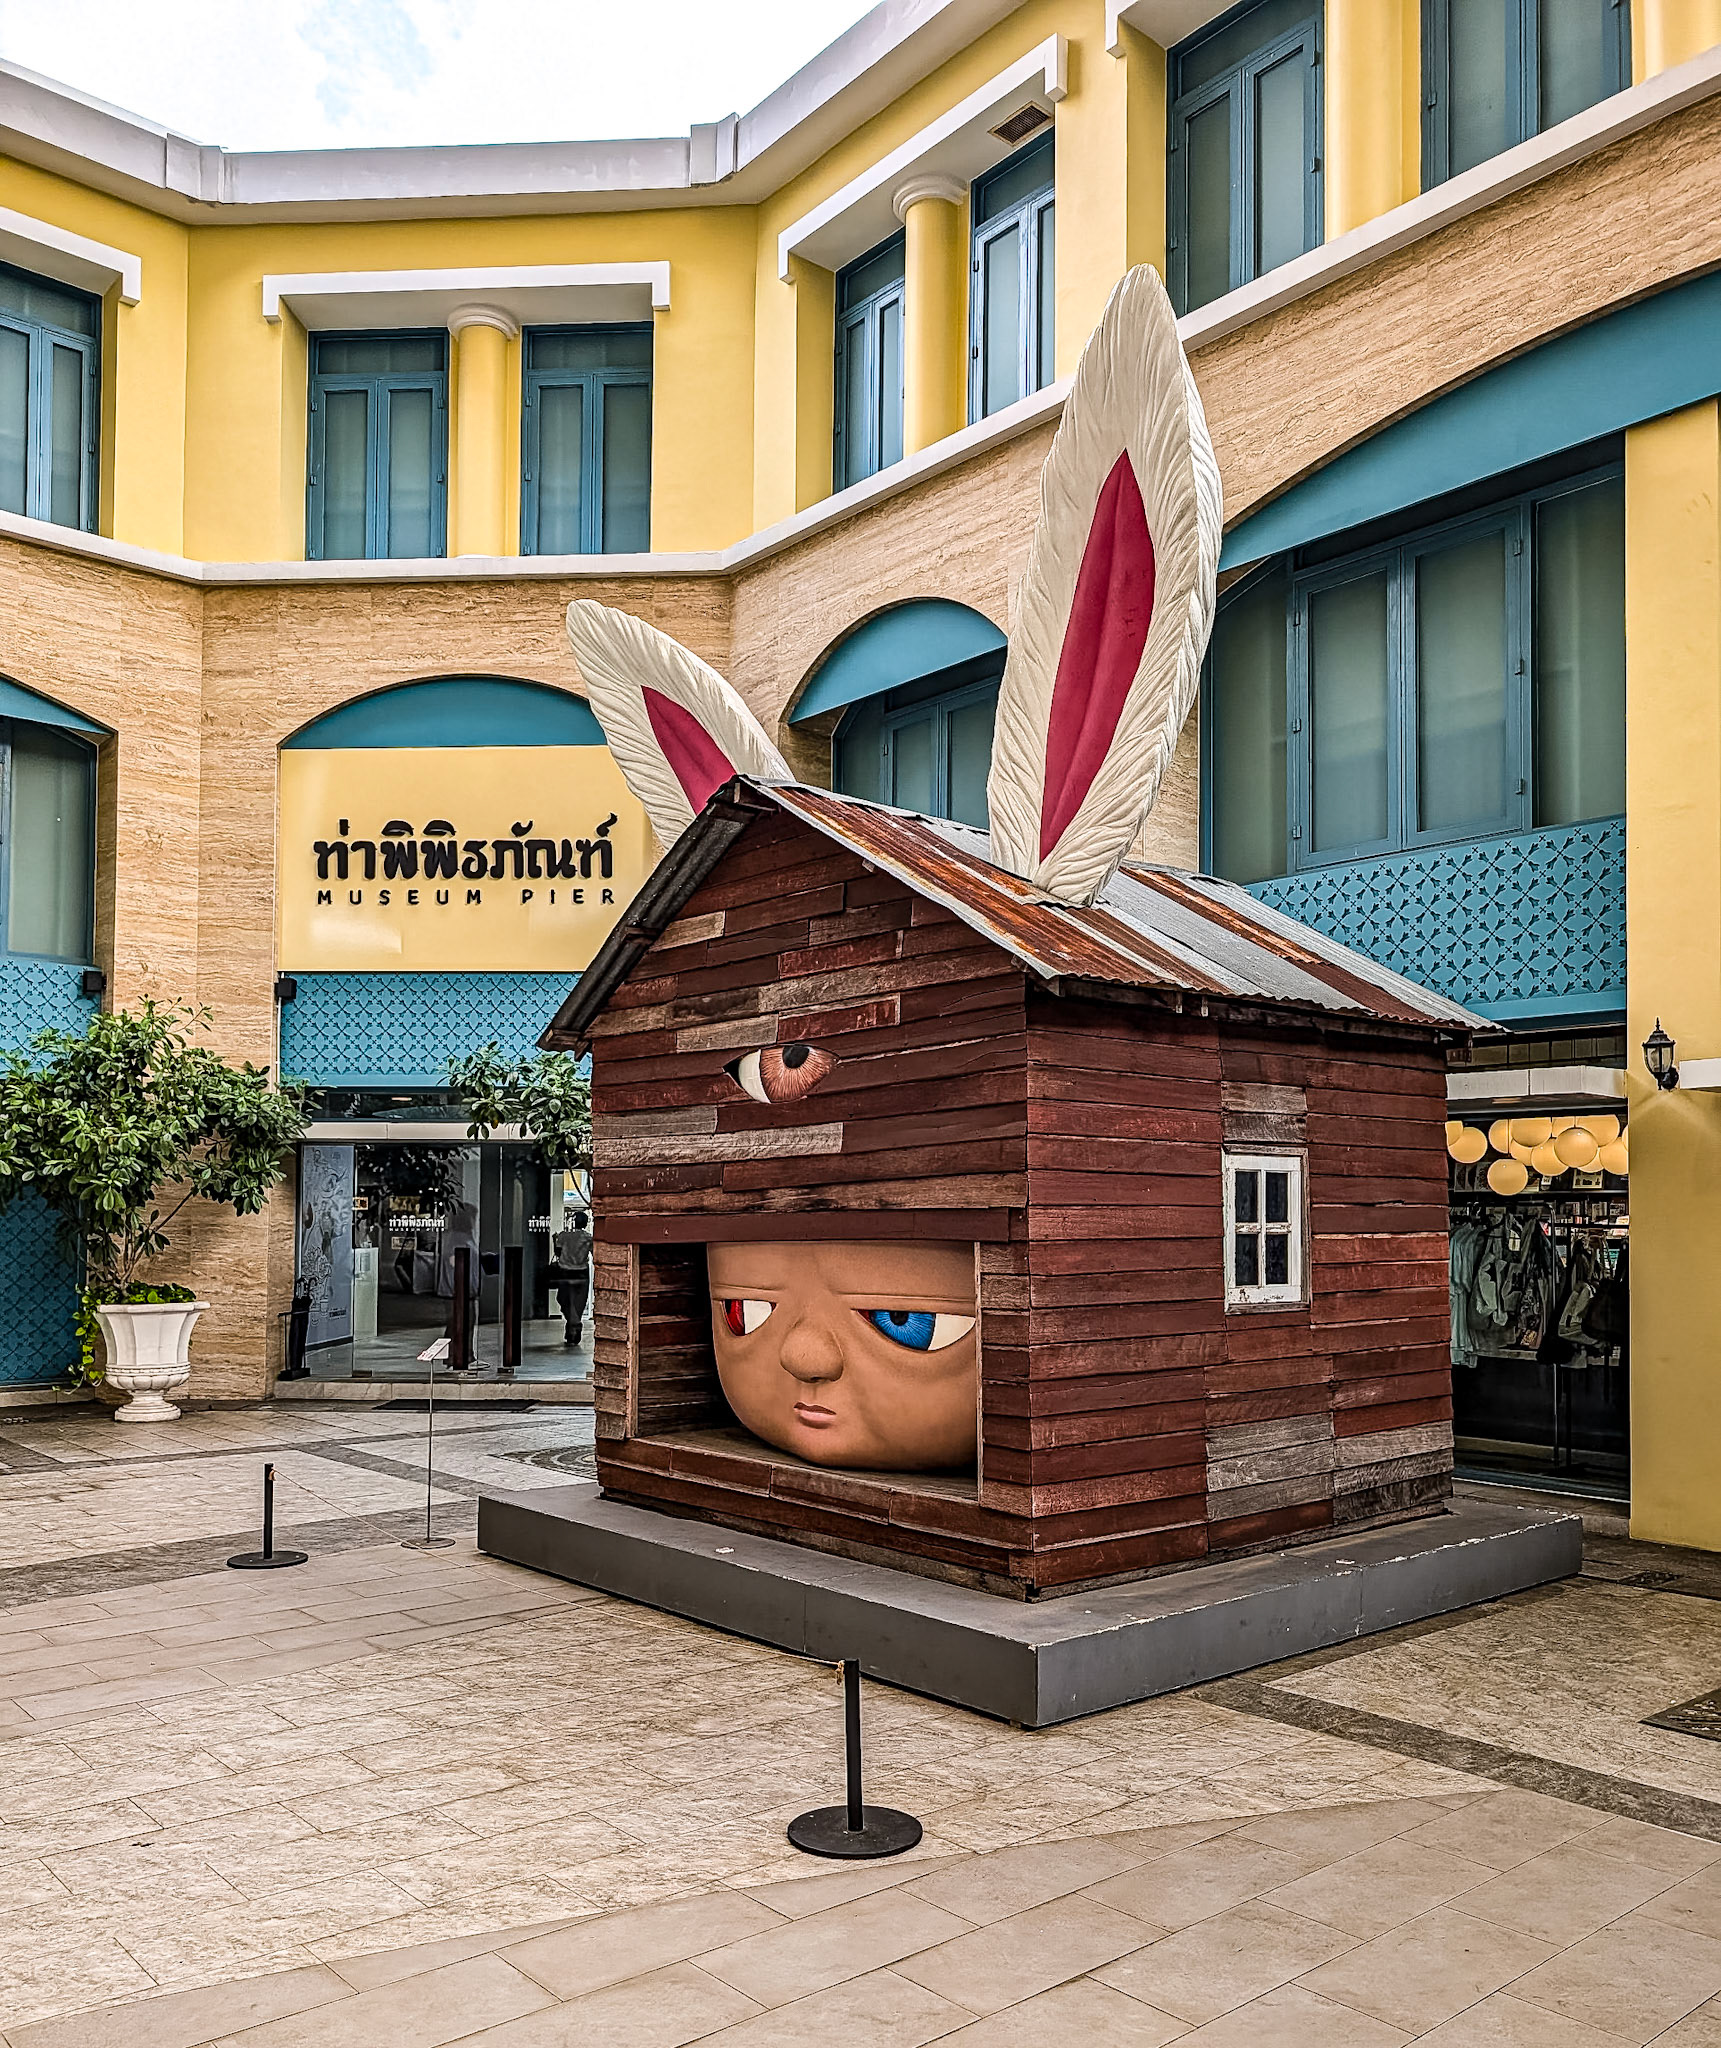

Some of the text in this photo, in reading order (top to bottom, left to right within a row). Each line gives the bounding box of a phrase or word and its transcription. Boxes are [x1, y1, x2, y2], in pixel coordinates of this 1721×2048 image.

[312, 812, 619, 880] ท่าพิพิธภัณฑ์
[316, 888, 616, 905] MUSEUM PIER
